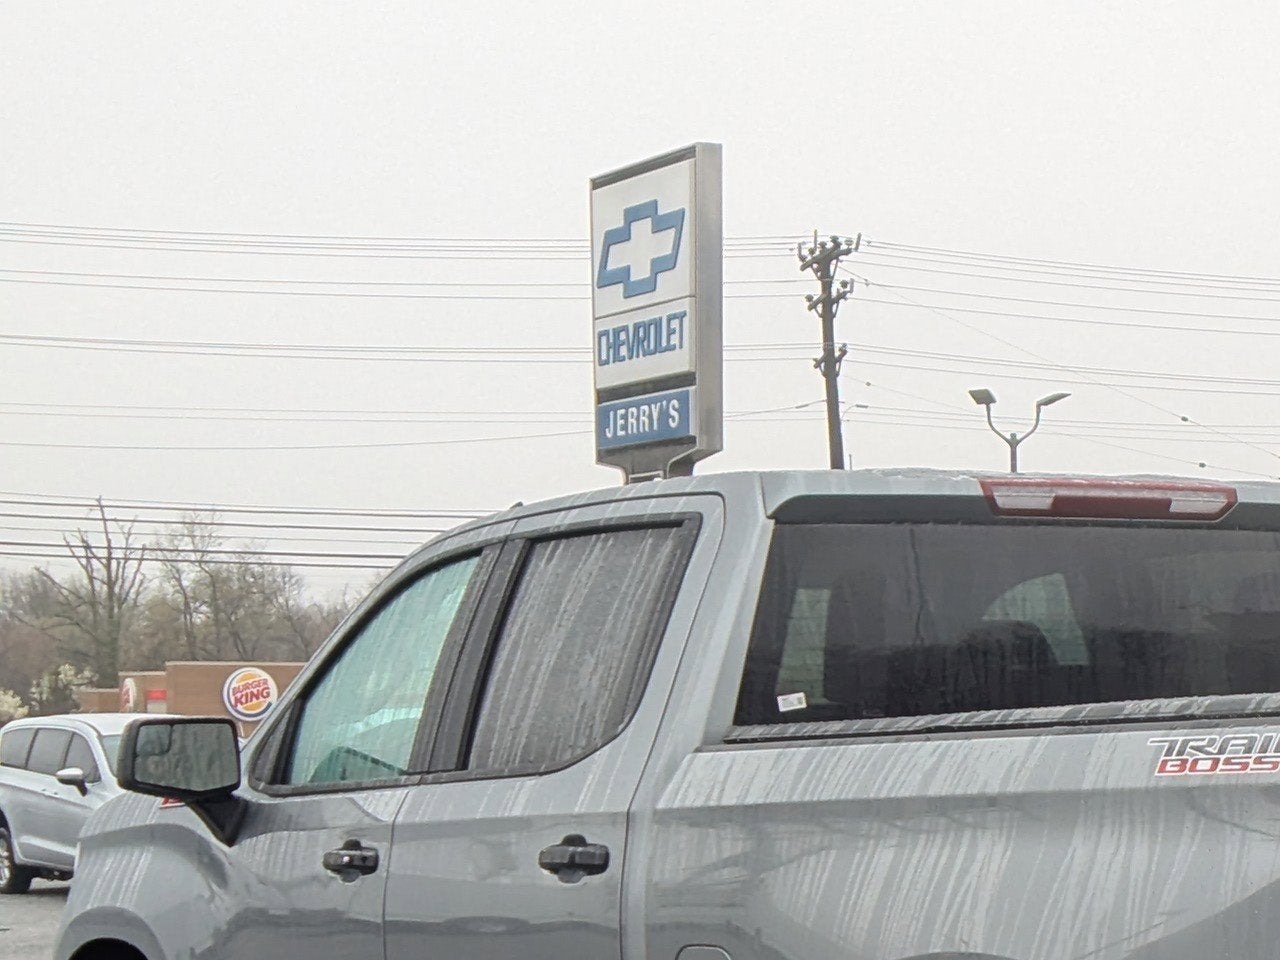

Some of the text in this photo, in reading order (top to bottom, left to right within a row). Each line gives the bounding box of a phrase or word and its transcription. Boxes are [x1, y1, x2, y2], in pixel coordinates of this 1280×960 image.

[597, 311, 687, 366] CHEVROLET
[606, 399, 680, 438] JERRY'S
[232, 678, 268, 697] BURGER
[234, 687, 271, 707] KING
